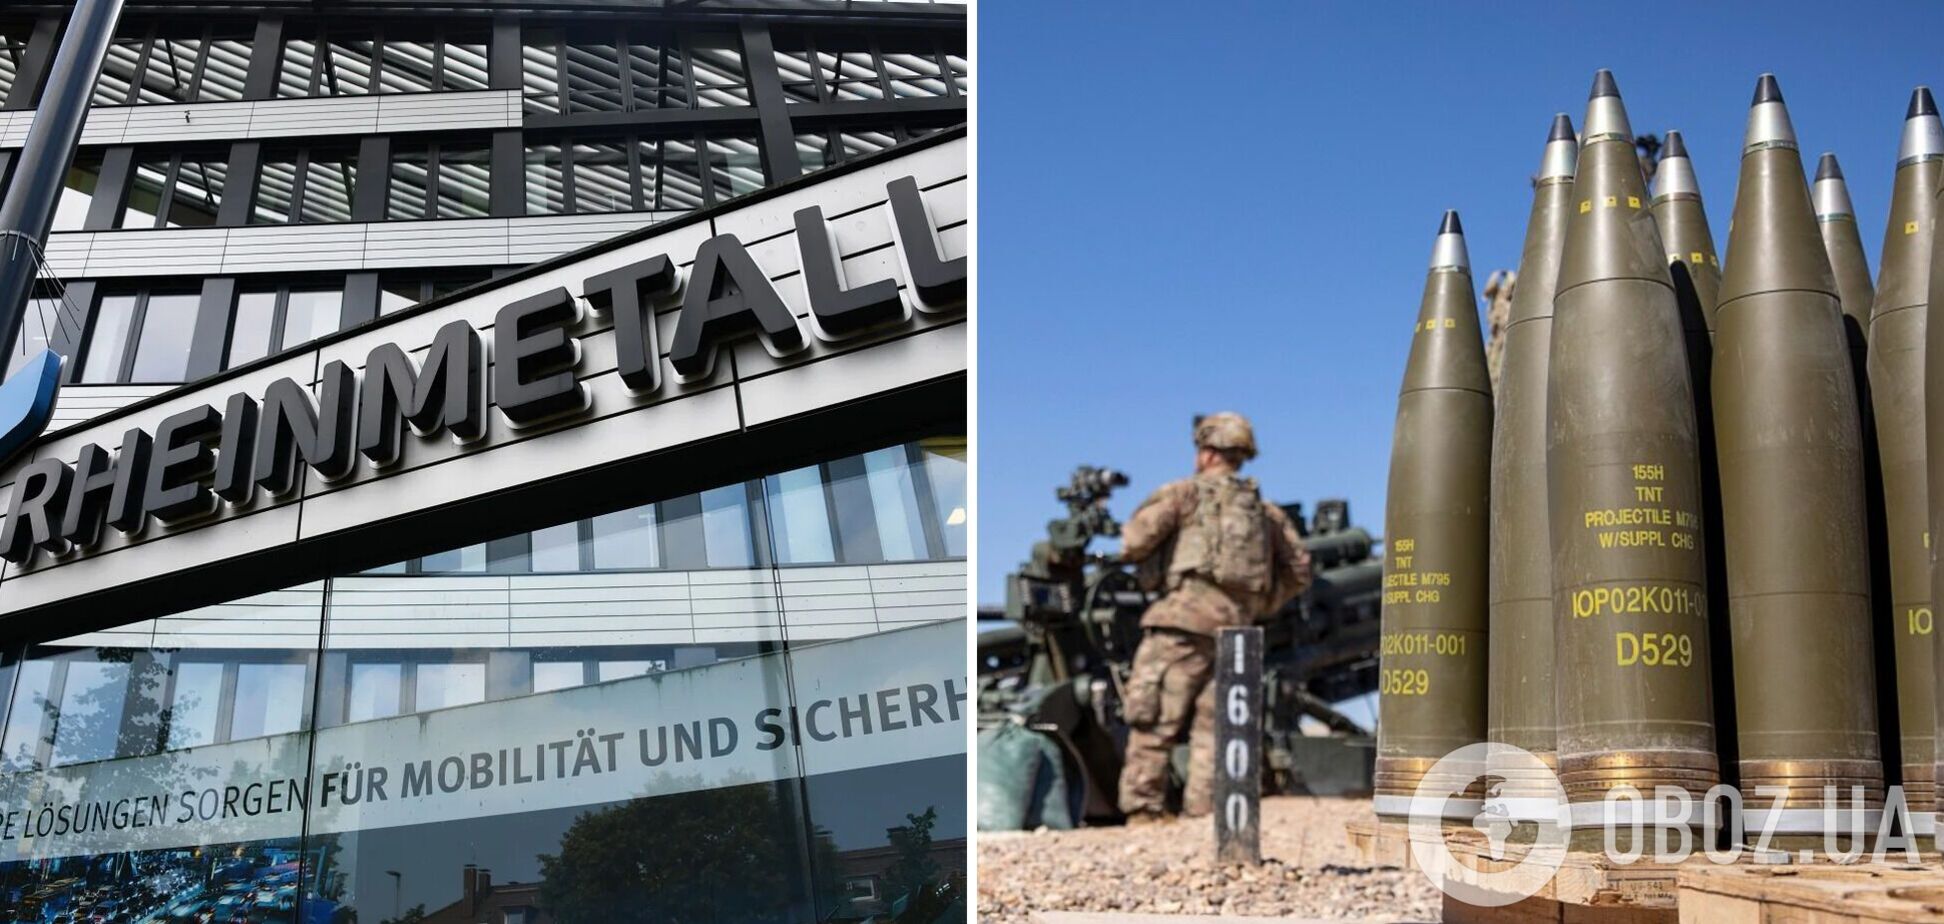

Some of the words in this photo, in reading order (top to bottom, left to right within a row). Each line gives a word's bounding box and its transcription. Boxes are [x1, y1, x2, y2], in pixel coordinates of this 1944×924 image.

[0, 175, 967, 565] RHEINMETALL
[1633, 464, 1664, 480] 155H
[1635, 487, 1664, 502] TNT
[1585, 508, 1671, 528] PROJECTILE
[1599, 531, 1665, 549] W/SUPPL
[1671, 532, 1695, 550] CHG
[1395, 556, 1413, 569] TNT
[1416, 590, 1440, 602] CHG
[1615, 632, 1693, 667] D529
[24, 794, 169, 838] LÖSUNGEN
[176, 776, 310, 824] SORGEN
[320, 761, 388, 807] FÜR
[401, 727, 624, 799] MOBILITÄT
[639, 716, 738, 767] UND
